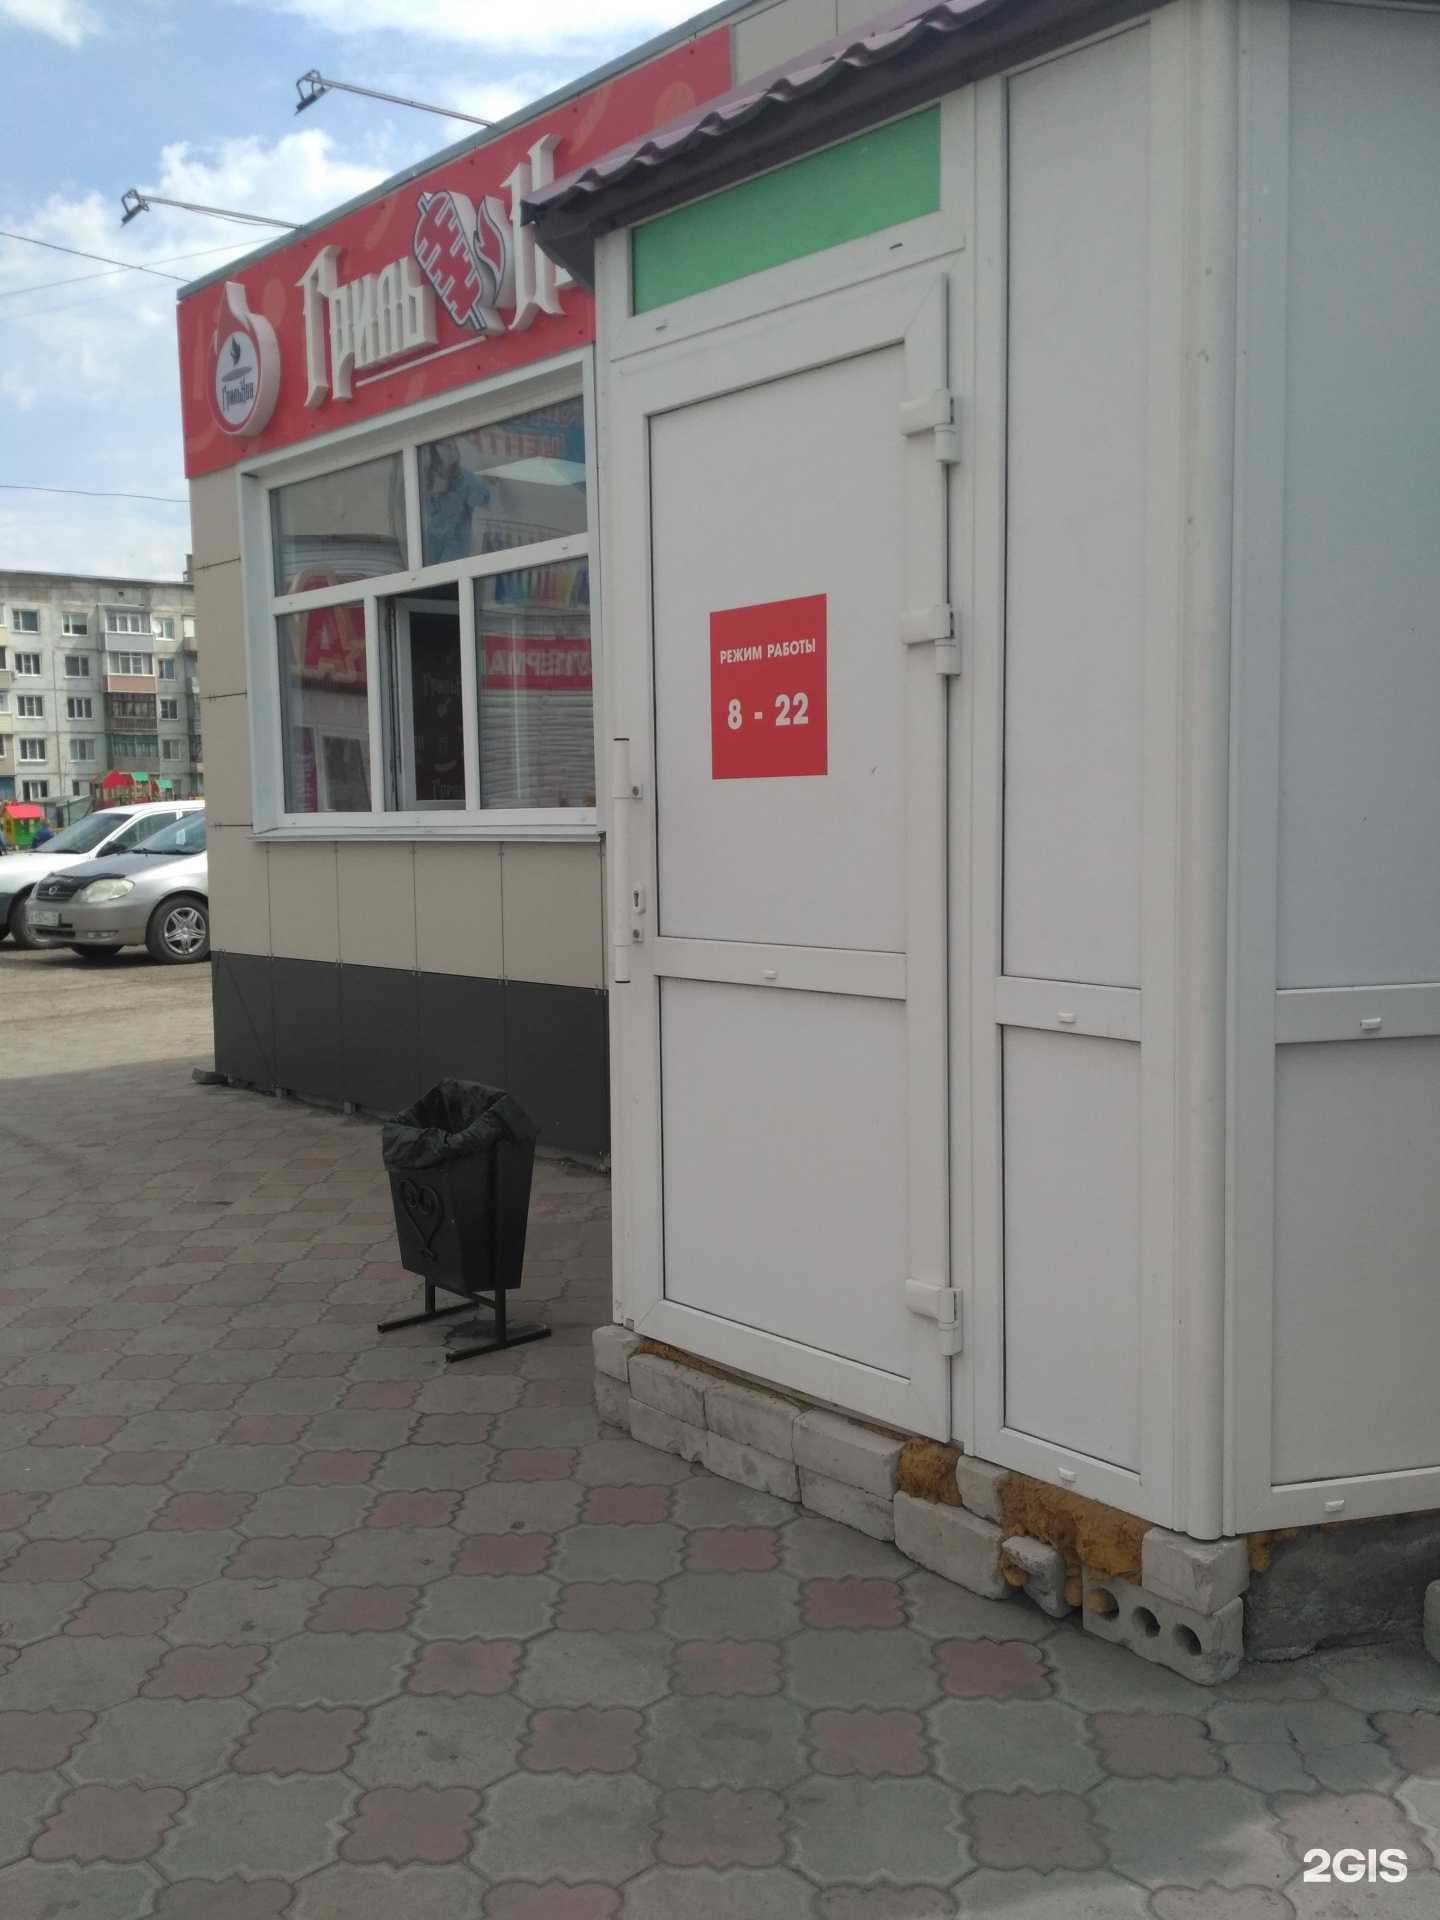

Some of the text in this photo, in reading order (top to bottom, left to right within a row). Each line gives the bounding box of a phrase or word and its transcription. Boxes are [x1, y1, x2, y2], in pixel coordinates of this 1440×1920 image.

[295, 245, 437, 408] Гриль
[720, 638, 816, 664] РЕЖИМ РАБОТЫ
[727, 698, 743, 731] 8
[775, 692, 809, 726] 22
